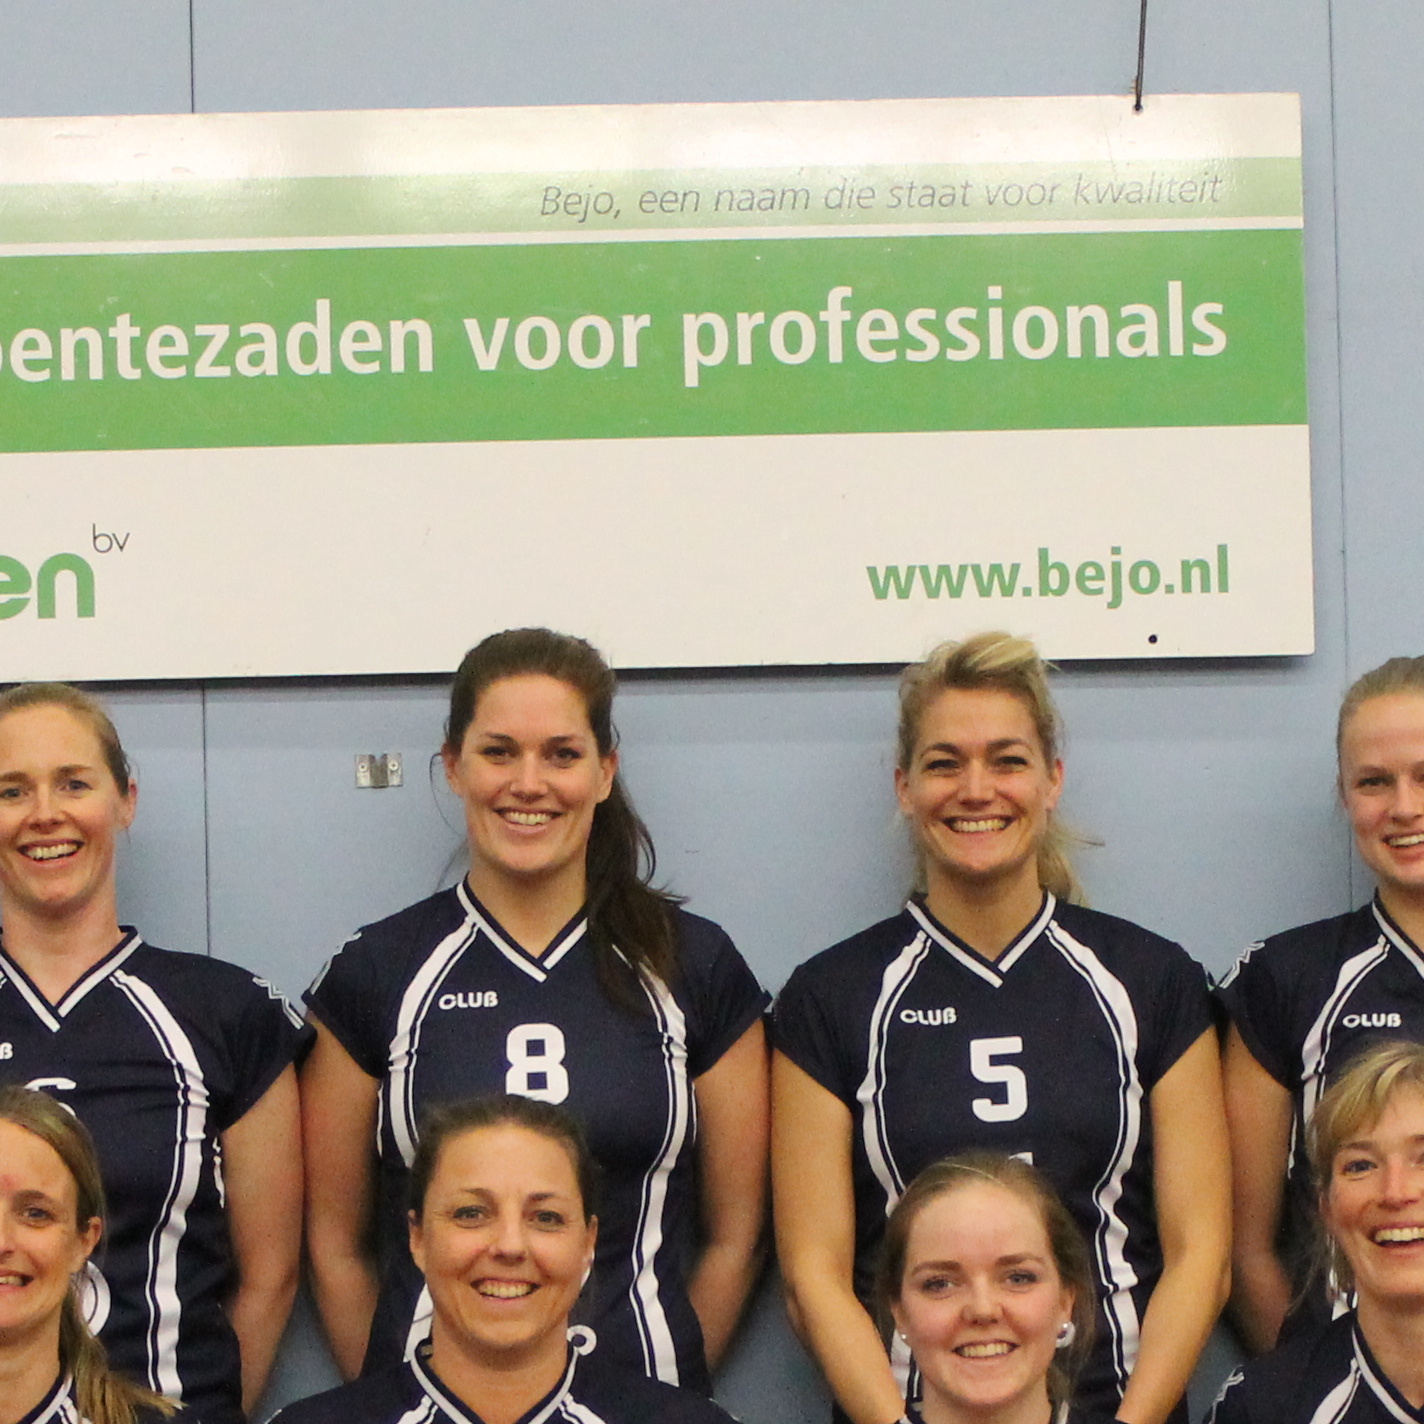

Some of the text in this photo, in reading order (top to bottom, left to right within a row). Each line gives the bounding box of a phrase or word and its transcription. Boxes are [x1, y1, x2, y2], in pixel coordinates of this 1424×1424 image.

[540, 171, 1224, 223] Bejo, een naam die staat voor kwaliteit
[463, 312, 652, 371] voor
[683, 280, 1228, 388] professionals
[92, 524, 130, 553] bv
[866, 544, 1229, 609] www.bejo.nl
[438, 991, 499, 1010] CLUB
[900, 1006, 957, 1026] CLUB
[1342, 1012, 1402, 1028] CLUB
[505, 1022, 570, 1106] 8
[969, 1035, 1028, 1123] 5
